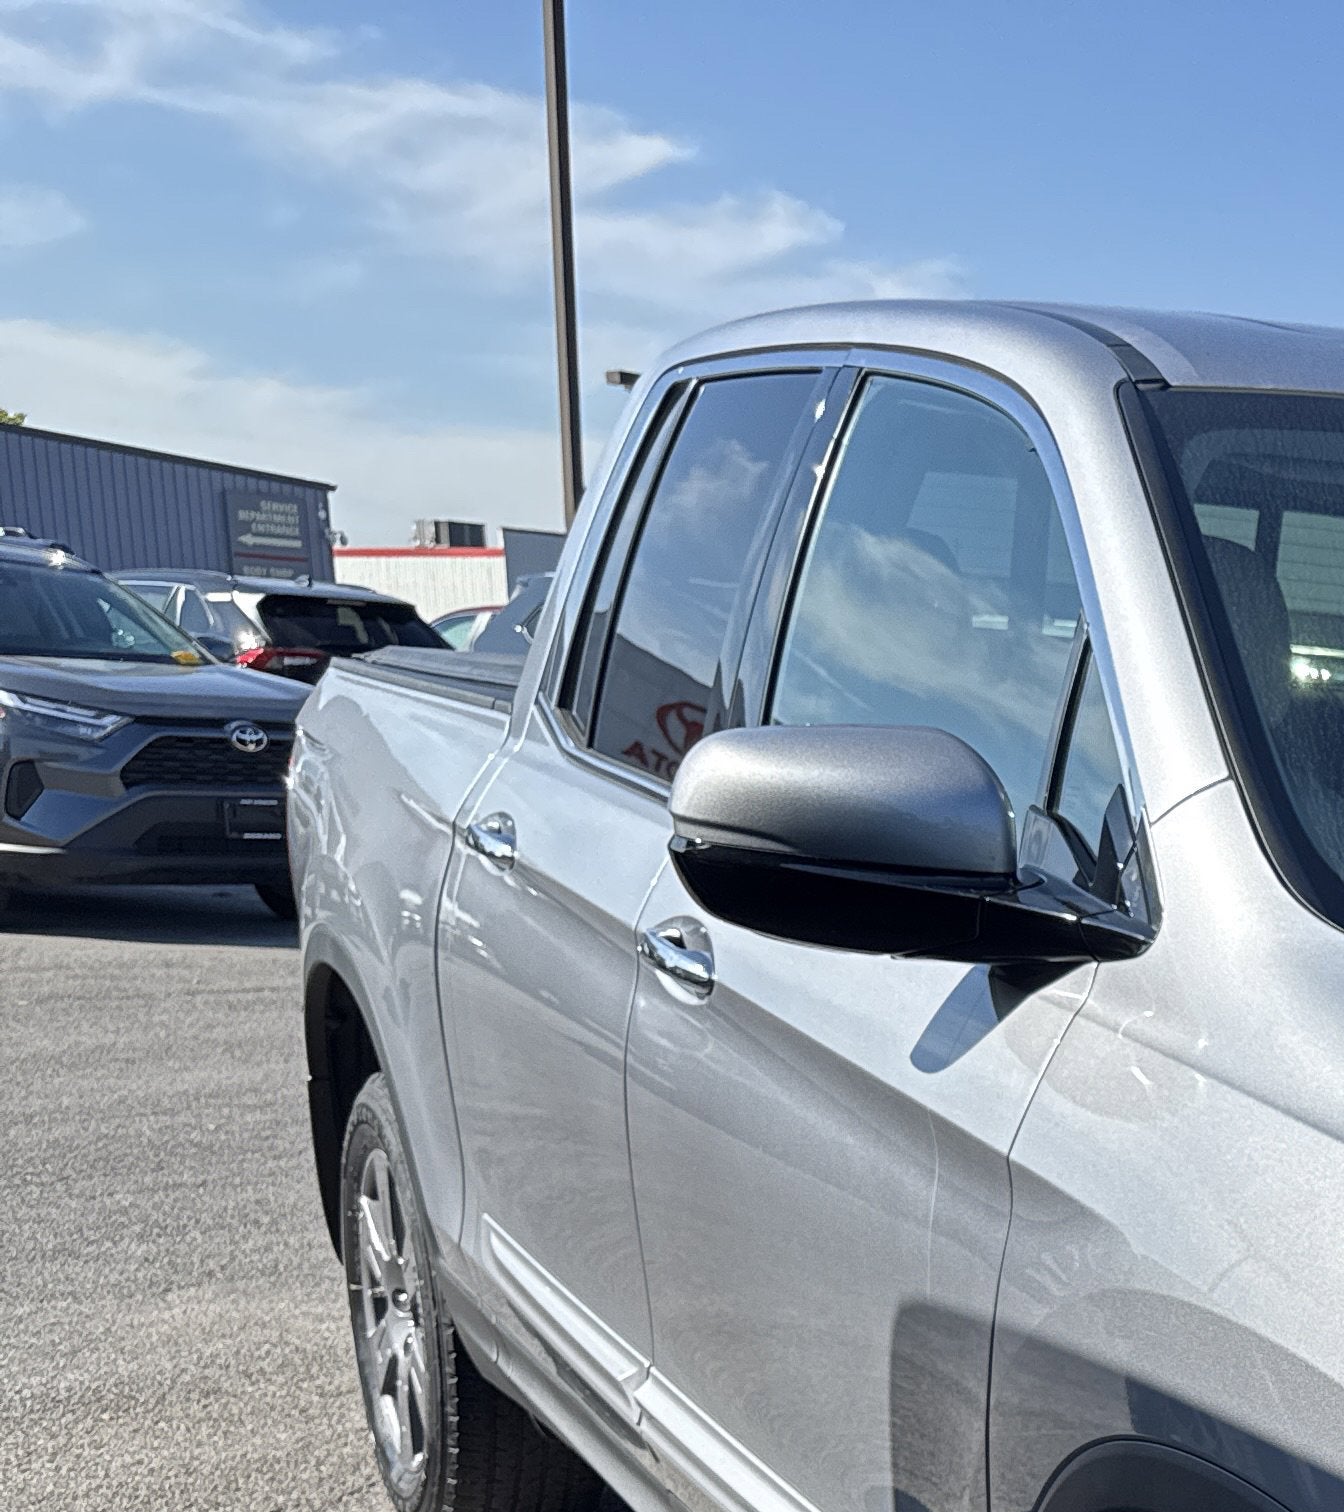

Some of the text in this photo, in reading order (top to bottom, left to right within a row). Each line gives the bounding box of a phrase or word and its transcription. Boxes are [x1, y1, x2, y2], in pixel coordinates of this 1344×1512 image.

[260, 500, 298, 513] SERVICE
[238, 509, 300, 524] DEPARTMENT
[251, 522, 300, 536] ENTRANCE
[242, 565, 295, 578] BODY SHOP
